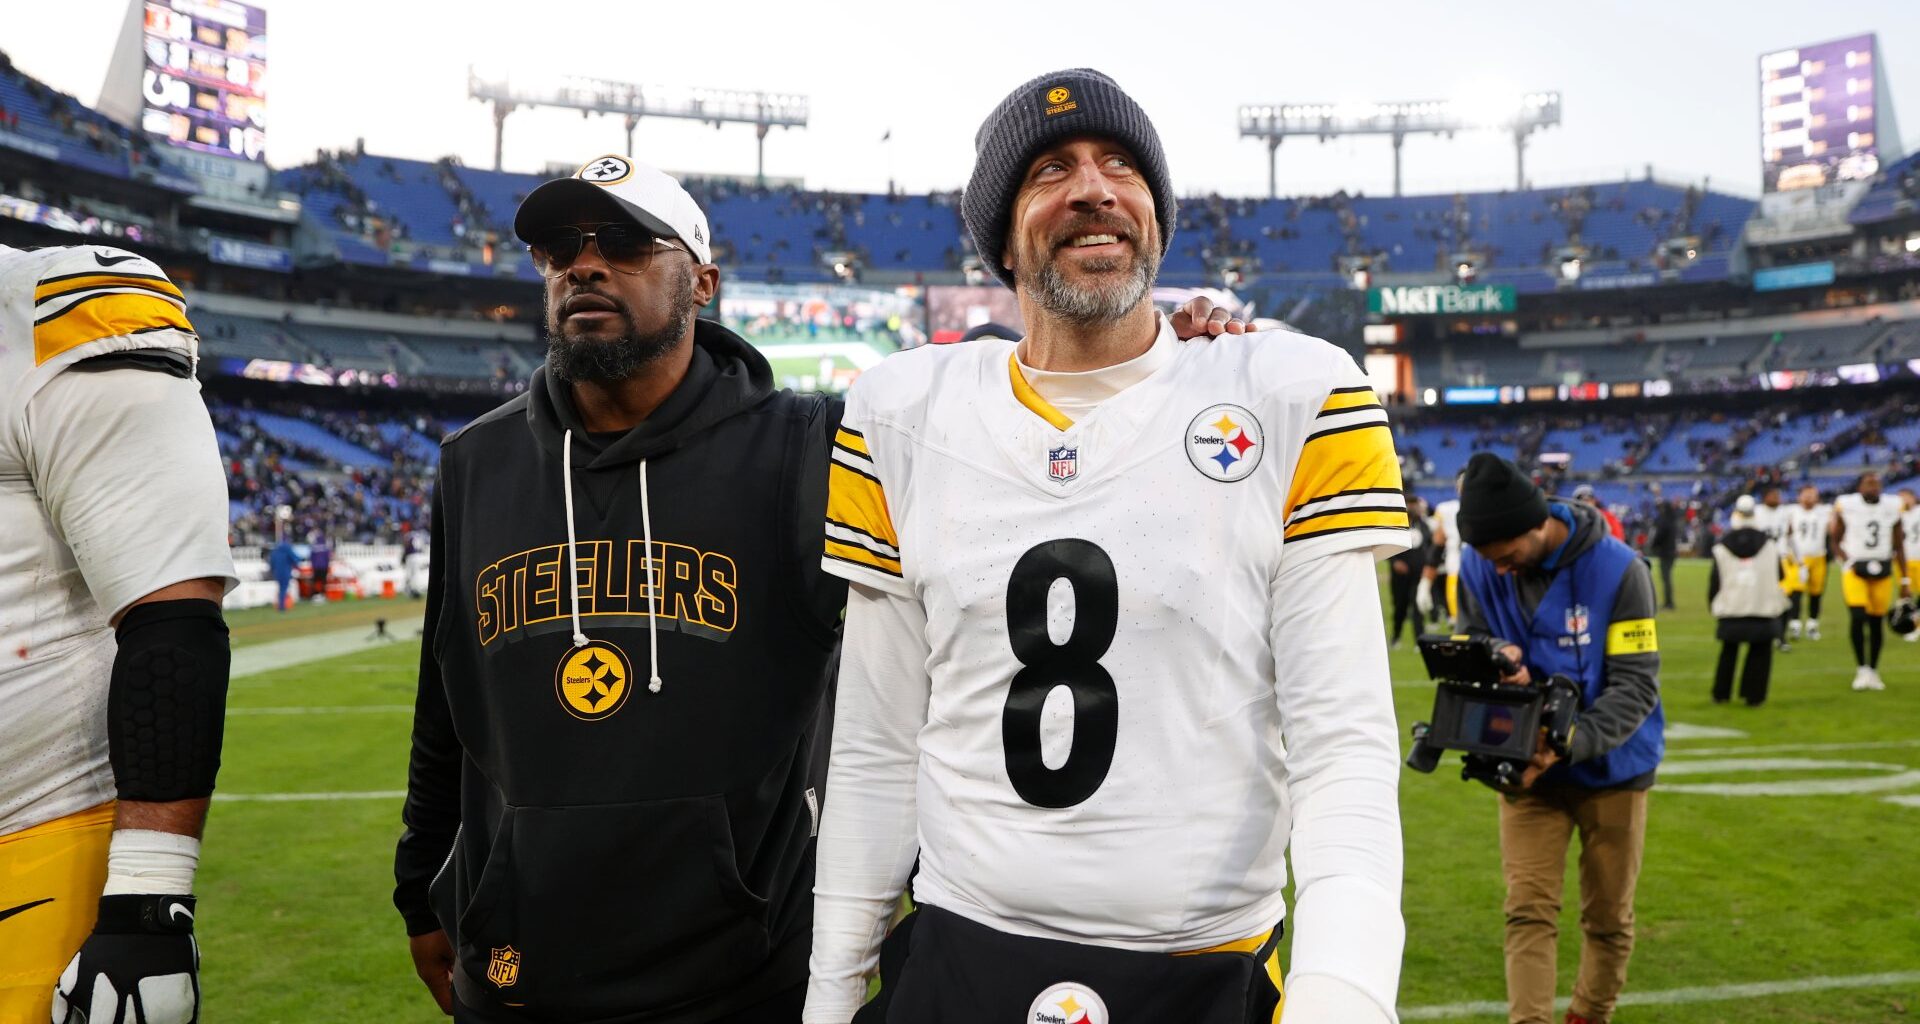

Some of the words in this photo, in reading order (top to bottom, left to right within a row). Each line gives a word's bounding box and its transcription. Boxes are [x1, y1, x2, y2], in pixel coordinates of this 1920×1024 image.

[1442, 285, 1504, 313] Bank
[1194, 435, 1225, 446] Steelers
[1051, 461, 1075, 477] NFL
[1865, 520, 1880, 548] 3
[476, 539, 738, 647] STEELERS
[566, 675, 591, 685] Steelers
[1002, 538, 1119, 809] 8
[491, 961, 515, 983] NFL
[1036, 1012, 1066, 1024] Steelers
